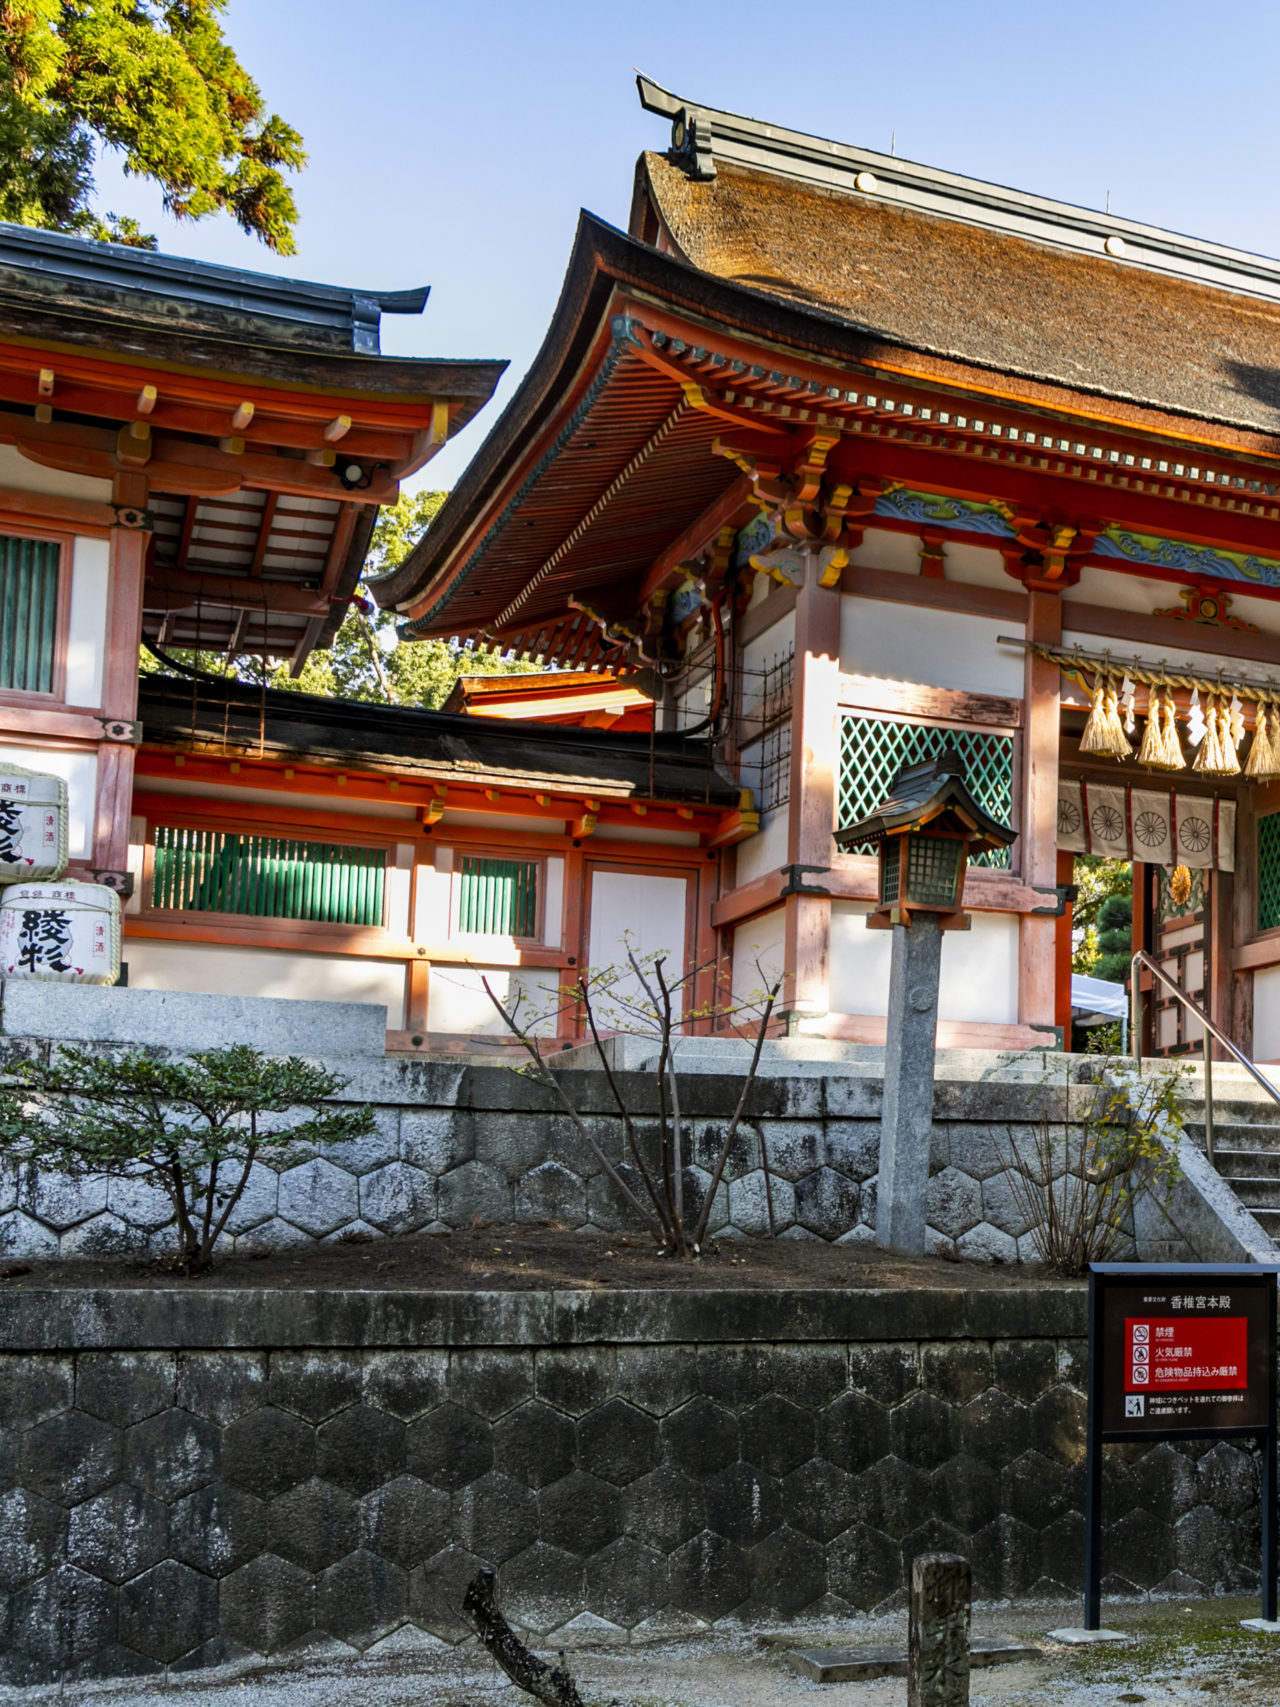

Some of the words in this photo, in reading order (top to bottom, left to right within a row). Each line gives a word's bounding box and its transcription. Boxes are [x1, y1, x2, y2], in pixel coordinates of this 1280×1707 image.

[1, 783, 26, 794] 商標
[45, 815, 54, 842] 清酒
[18, 910, 73, 973] 綾杉
[95, 926, 104, 953] 清酒
[1170, 1295, 1232, 1309] 香椎宮本殿
[1155, 1326, 1175, 1338] 禁煙
[1155, 1347, 1193, 1358] 火気厳禁
[1155, 1366, 1238, 1378] 危険物品持込み厳禁
